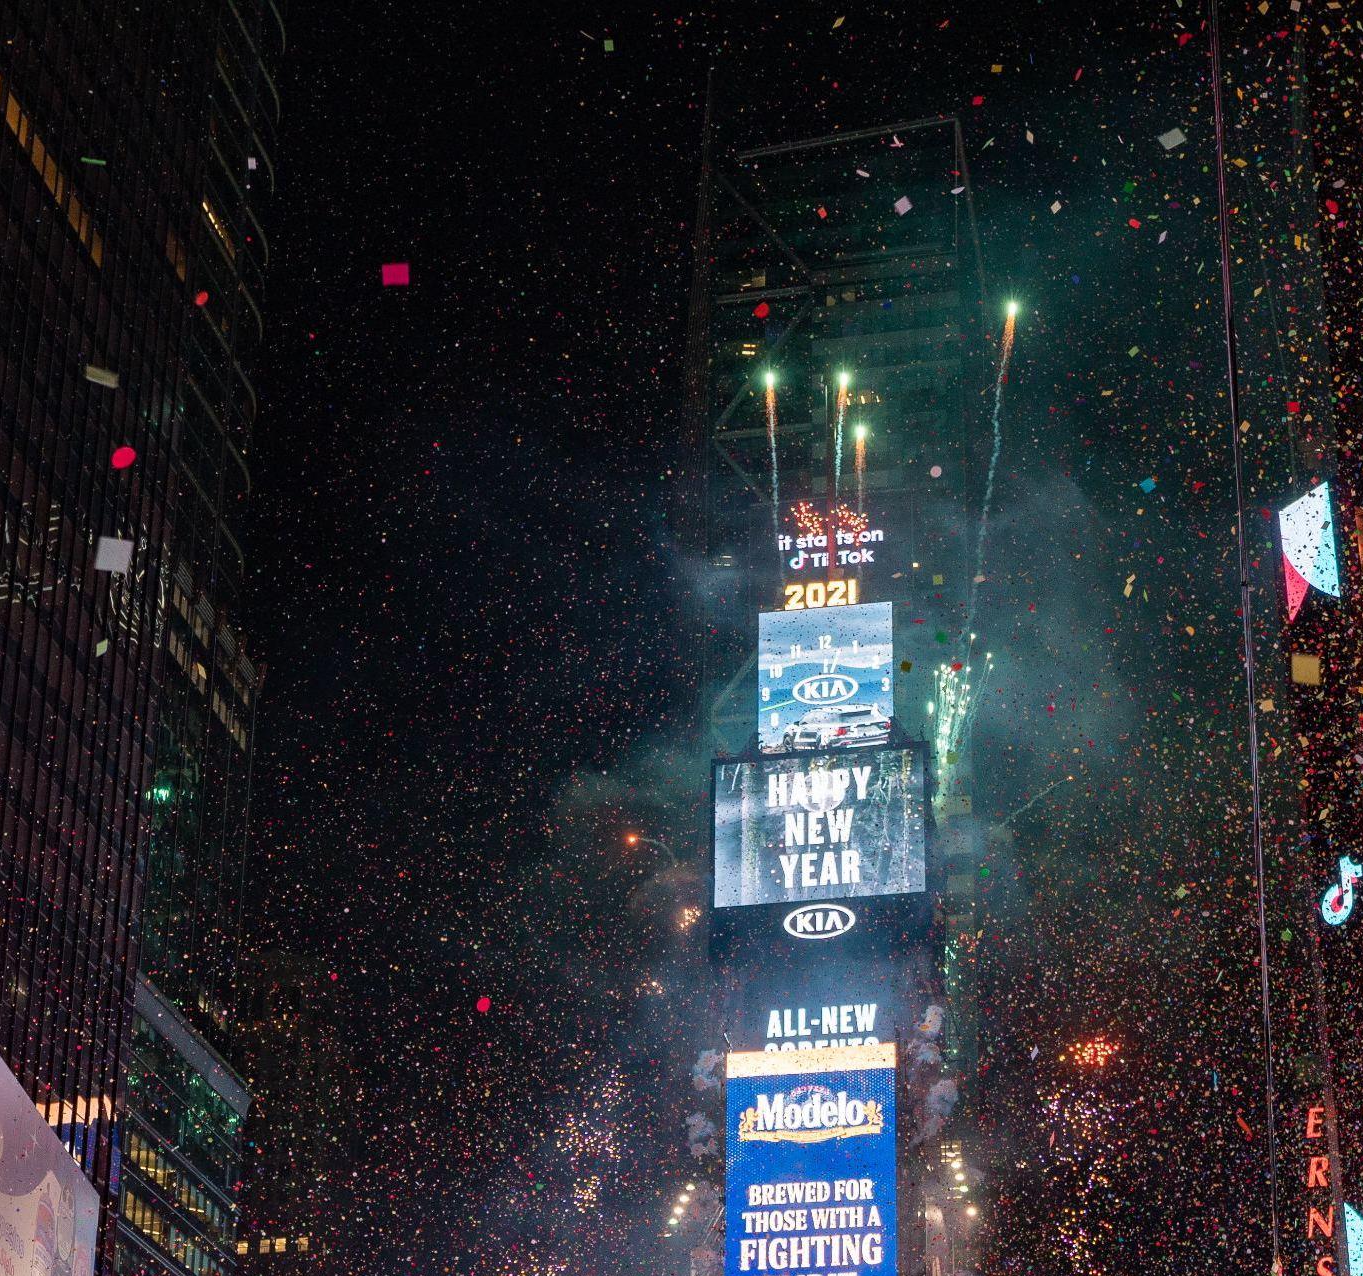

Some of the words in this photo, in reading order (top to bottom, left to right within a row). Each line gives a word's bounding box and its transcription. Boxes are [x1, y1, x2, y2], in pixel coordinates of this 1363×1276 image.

[778, 535, 793, 551] it
[795, 528, 855, 551] stats
[858, 527, 884, 545] on
[812, 547, 875, 569] TiTok
[784, 579, 857, 611] 2021
[804, 678, 848, 699] KIA
[768, 766, 872, 808] HAPPY
[785, 810, 854, 846] NEW
[779, 849, 860, 888] YEAR
[795, 910, 842, 933] KIA
[767, 1003, 877, 1038] ALL-NEW
[755, 1090, 866, 1132] Modelo
[748, 1180, 831, 1206] BREWED
[834, 1178, 874, 1201] FOR
[742, 1208, 808, 1234] THOSE
[811, 1207, 864, 1232] WITH
[867, 1206, 882, 1228] A
[739, 1232, 883, 1272] FIGHTING
